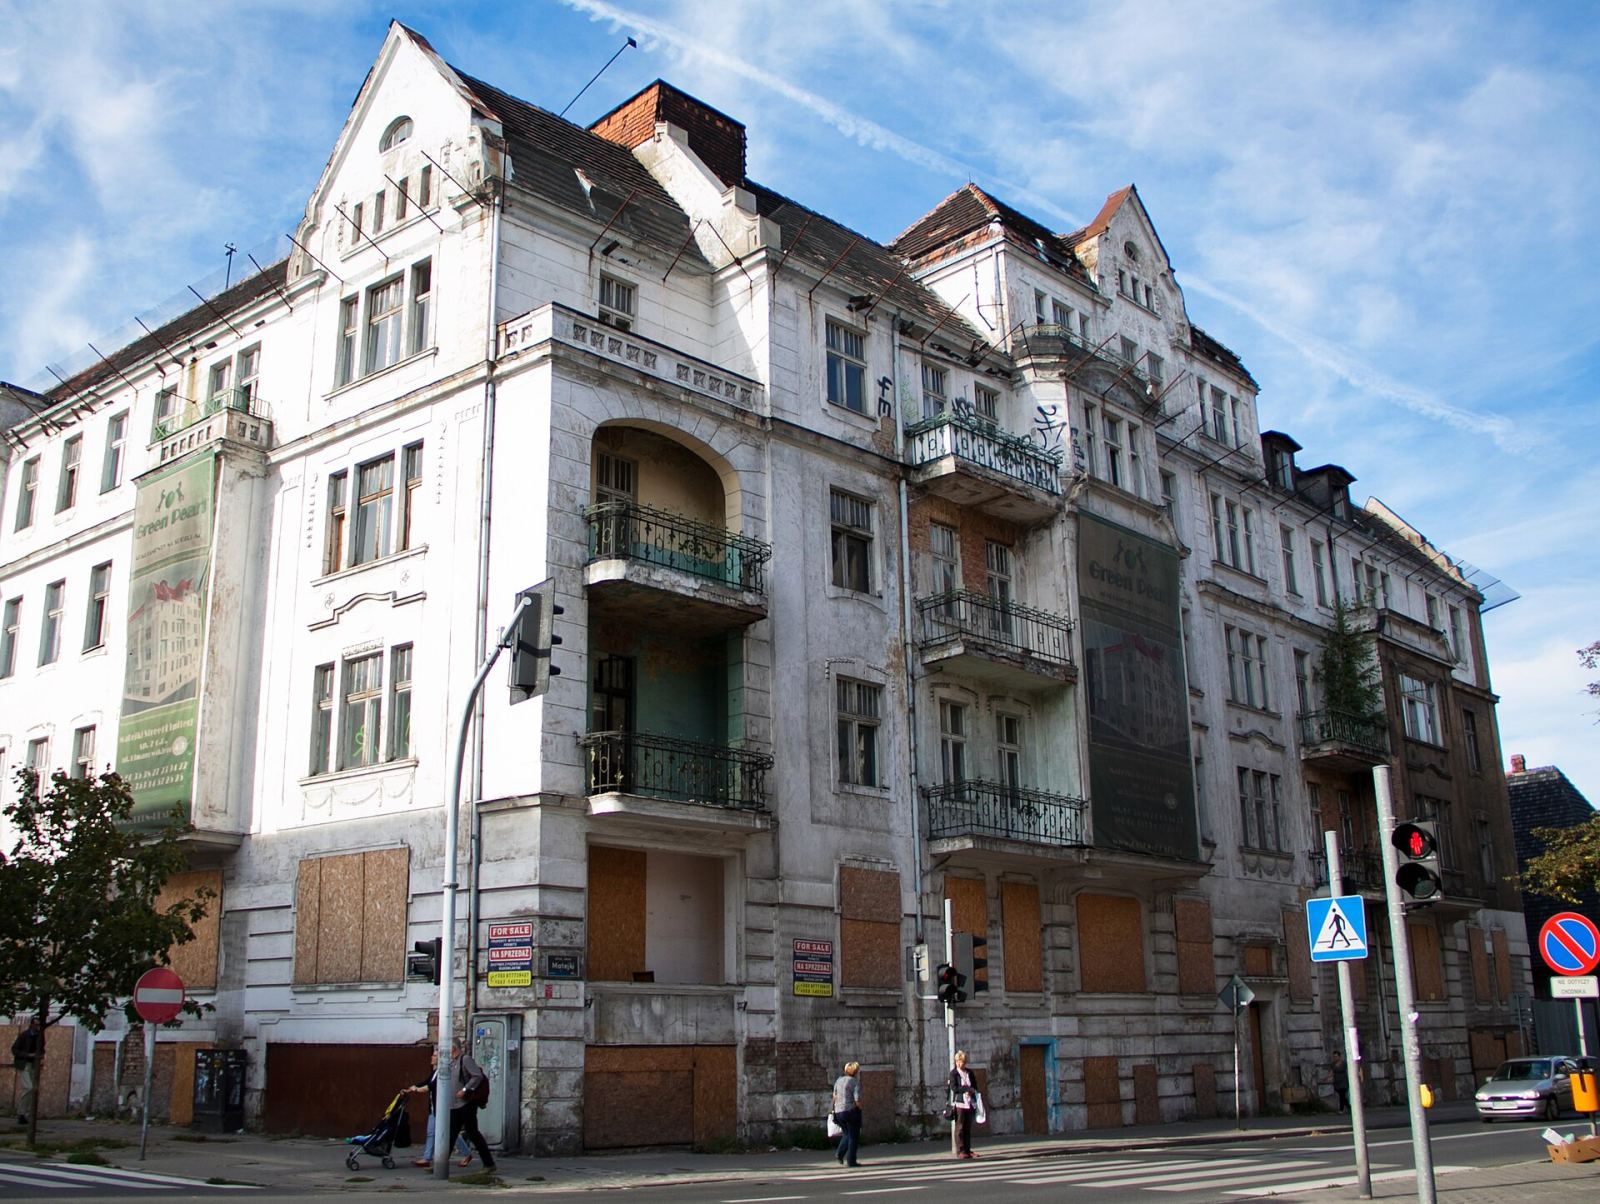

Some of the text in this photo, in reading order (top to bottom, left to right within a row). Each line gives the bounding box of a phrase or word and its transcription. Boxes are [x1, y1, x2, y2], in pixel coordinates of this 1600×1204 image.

[135, 515, 169, 540] Green
[170, 499, 207, 525] Pearl
[1088, 560, 1133, 592] Green
[492, 926, 530, 936] FOR SALE
[796, 942, 830, 952] FOR SALE
[491, 950, 500, 959] NA
[796, 962, 805, 970] NA
